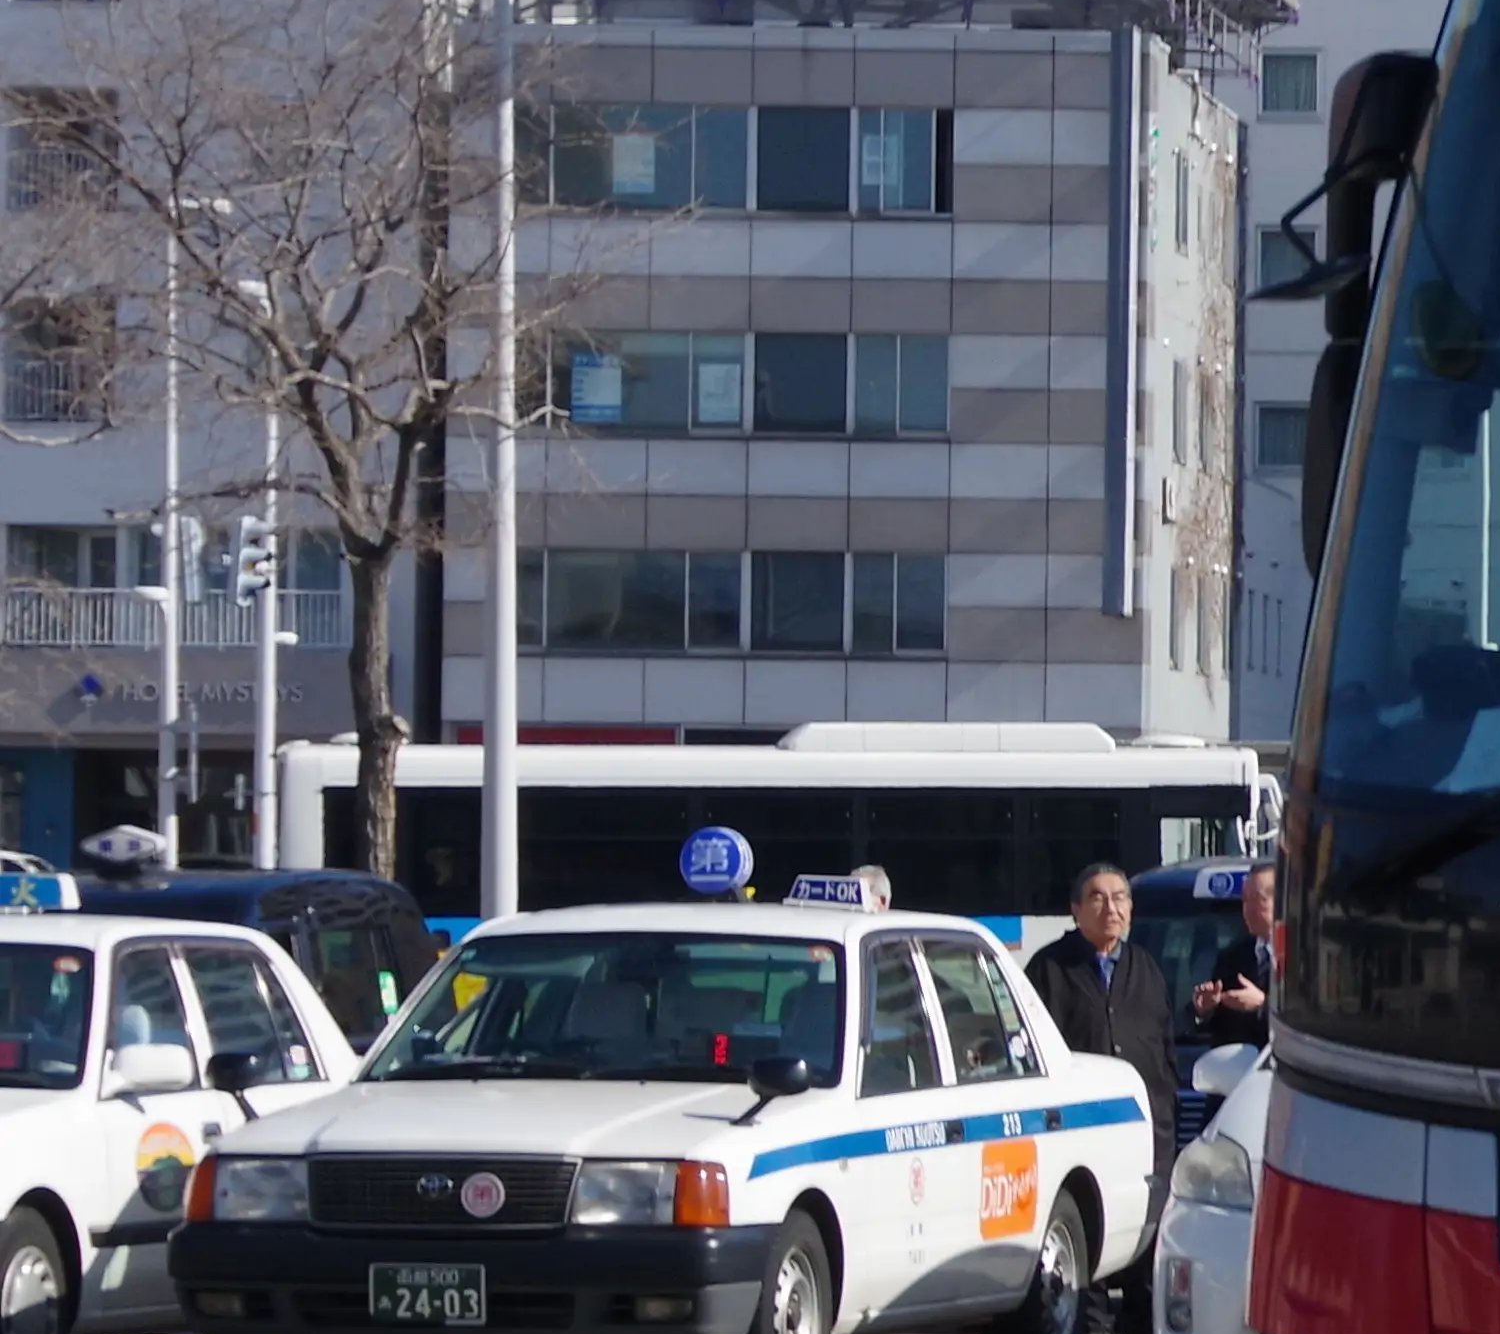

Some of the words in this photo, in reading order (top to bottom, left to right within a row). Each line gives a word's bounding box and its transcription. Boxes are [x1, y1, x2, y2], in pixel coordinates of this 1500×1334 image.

[121, 681, 192, 702] HOEL
[797, 879, 859, 902] カードOK
[396, 1287, 480, 1319] 24-03
